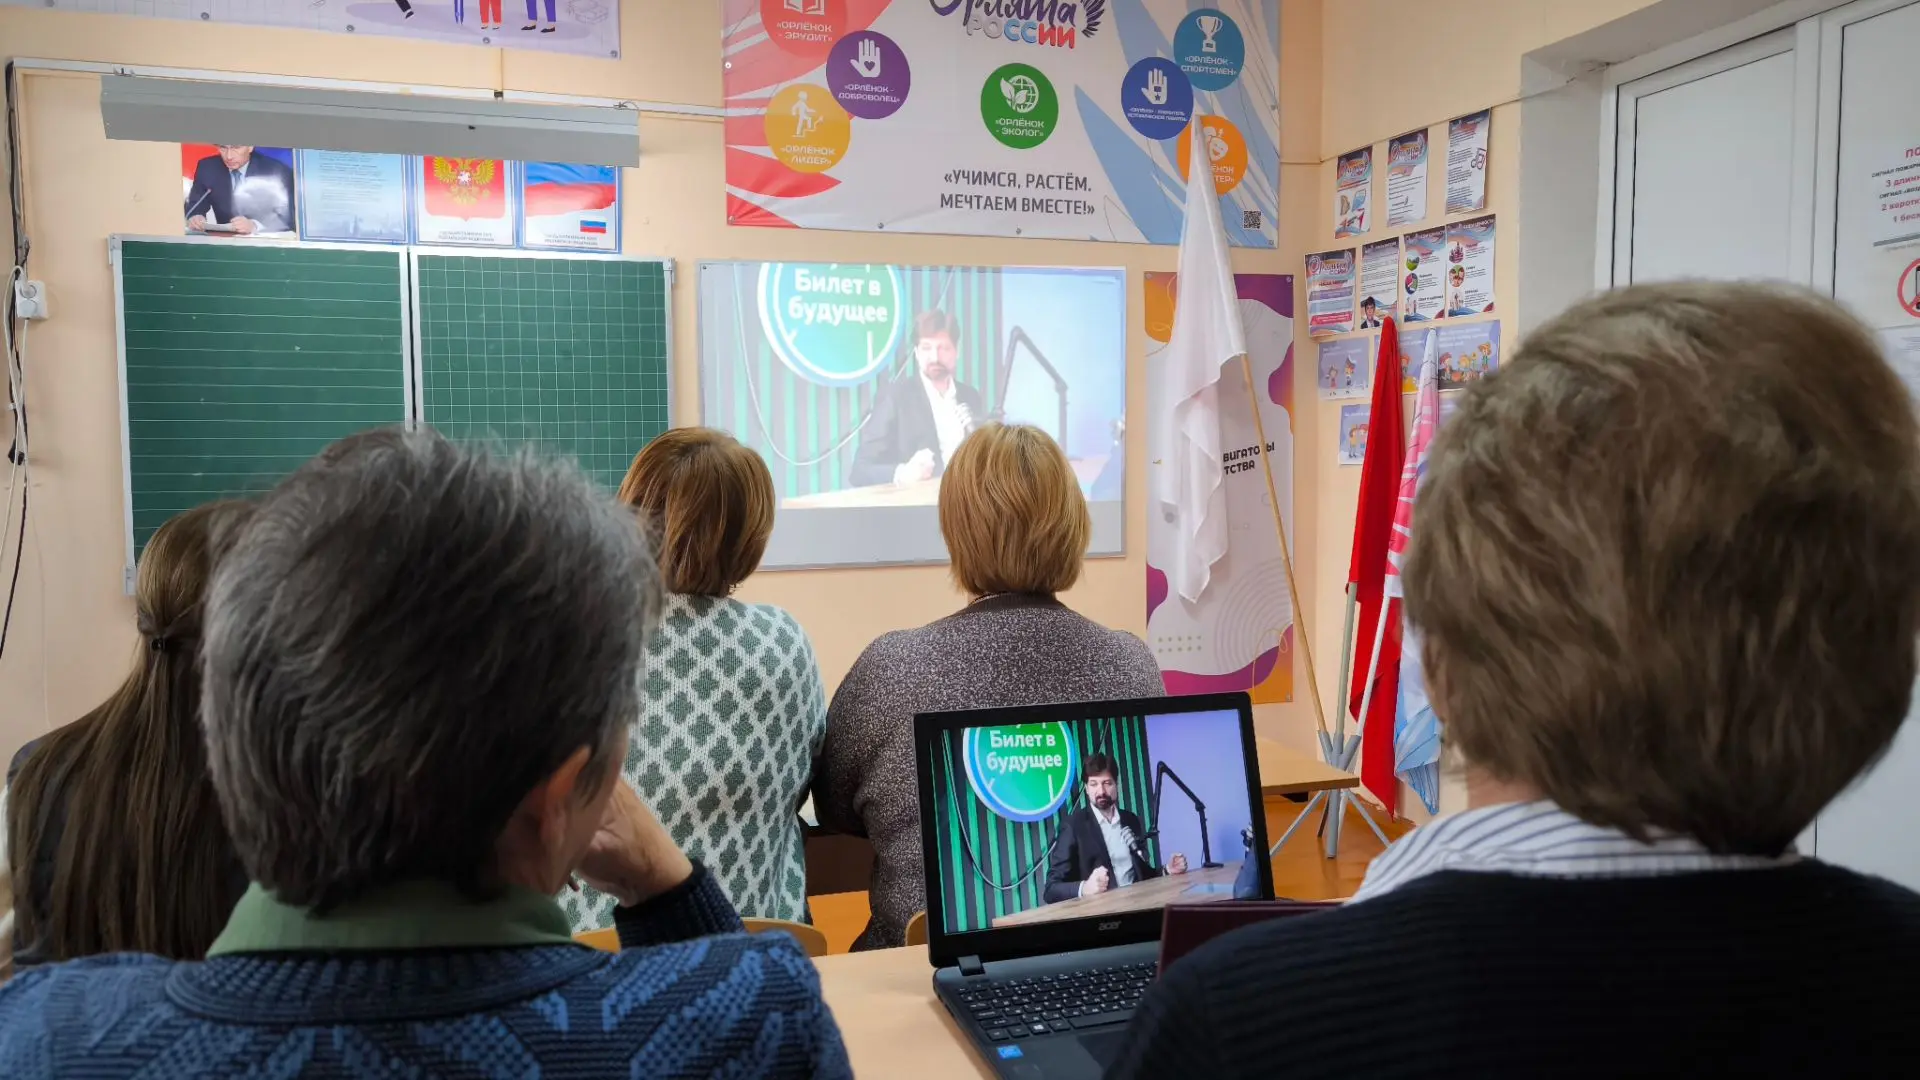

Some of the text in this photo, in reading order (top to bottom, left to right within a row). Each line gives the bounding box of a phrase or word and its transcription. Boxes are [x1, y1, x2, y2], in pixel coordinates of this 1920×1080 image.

[930, 0, 1076, 28] рлята
[944, 168, 1021, 189] «УЧИМСЯ,
[940, 193, 1095, 215] МЕЧТАЕМ ВМЕСТЕ!»
[794, 268, 881, 296] Билет в
[788, 297, 888, 326] будущее
[1223, 441, 1275, 462] ВИГАТОЫ
[989, 730, 1056, 748] Билет в
[986, 751, 1063, 775] будущее
[1098, 920, 1122, 931] acer
